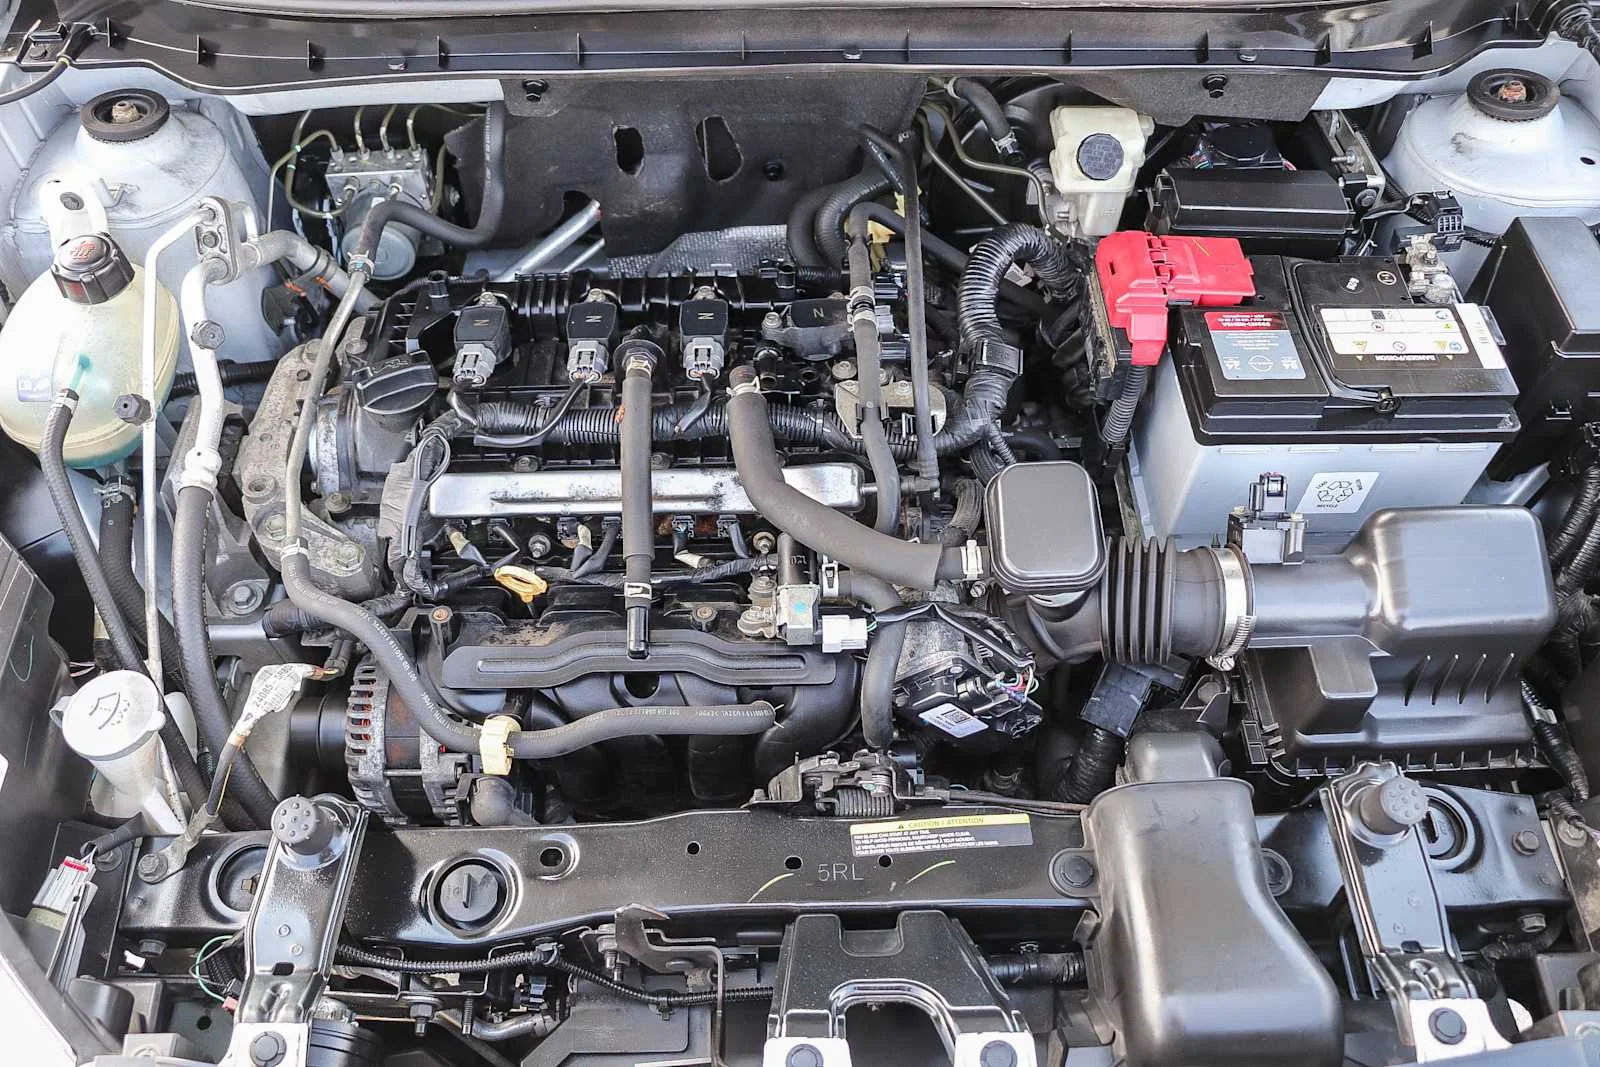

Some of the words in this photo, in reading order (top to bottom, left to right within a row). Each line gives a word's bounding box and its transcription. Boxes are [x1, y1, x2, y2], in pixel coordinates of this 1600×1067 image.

[908, 820, 940, 828] CAUTION
[947, 816, 984, 825] ATTENTION
[817, 862, 865, 882] 5RL
